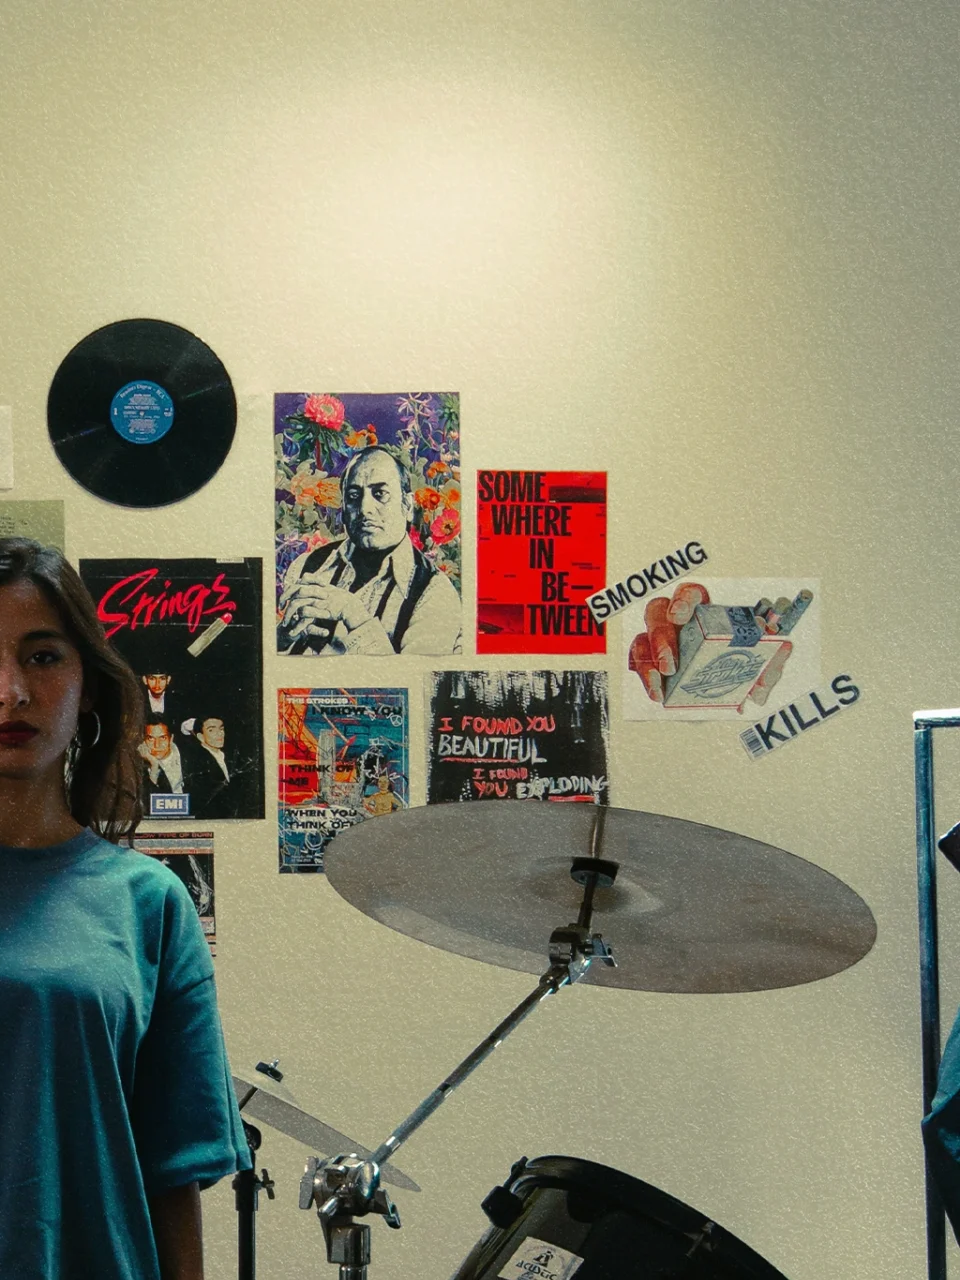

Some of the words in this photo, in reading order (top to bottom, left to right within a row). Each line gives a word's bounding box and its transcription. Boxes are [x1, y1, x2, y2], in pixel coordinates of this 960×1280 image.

[478, 470, 547, 503] SOME
[491, 504, 573, 537] WHERE
[529, 538, 555, 569] IN
[591, 541, 708, 618] SMOKING
[97, 567, 237, 640] Strings
[306, 697, 349, 705] STROKES
[373, 705, 403, 716] YOU
[754, 674, 860, 751] KILLS
[438, 717, 453, 732] I
[461, 715, 523, 735] FOUND
[525, 714, 556, 734] YOU
[437, 734, 548, 764] BEAUTIFUL
[289, 764, 331, 773] THINK
[335, 764, 355, 773] OF
[472, 768, 485, 780] I
[489, 767, 529, 780] FOUND
[473, 781, 508, 797] YOU
[155, 798, 184, 810] EMI
[286, 809, 327, 817] WHEN
[330, 809, 358, 817] YOU
[287, 821, 327, 829] THINK
